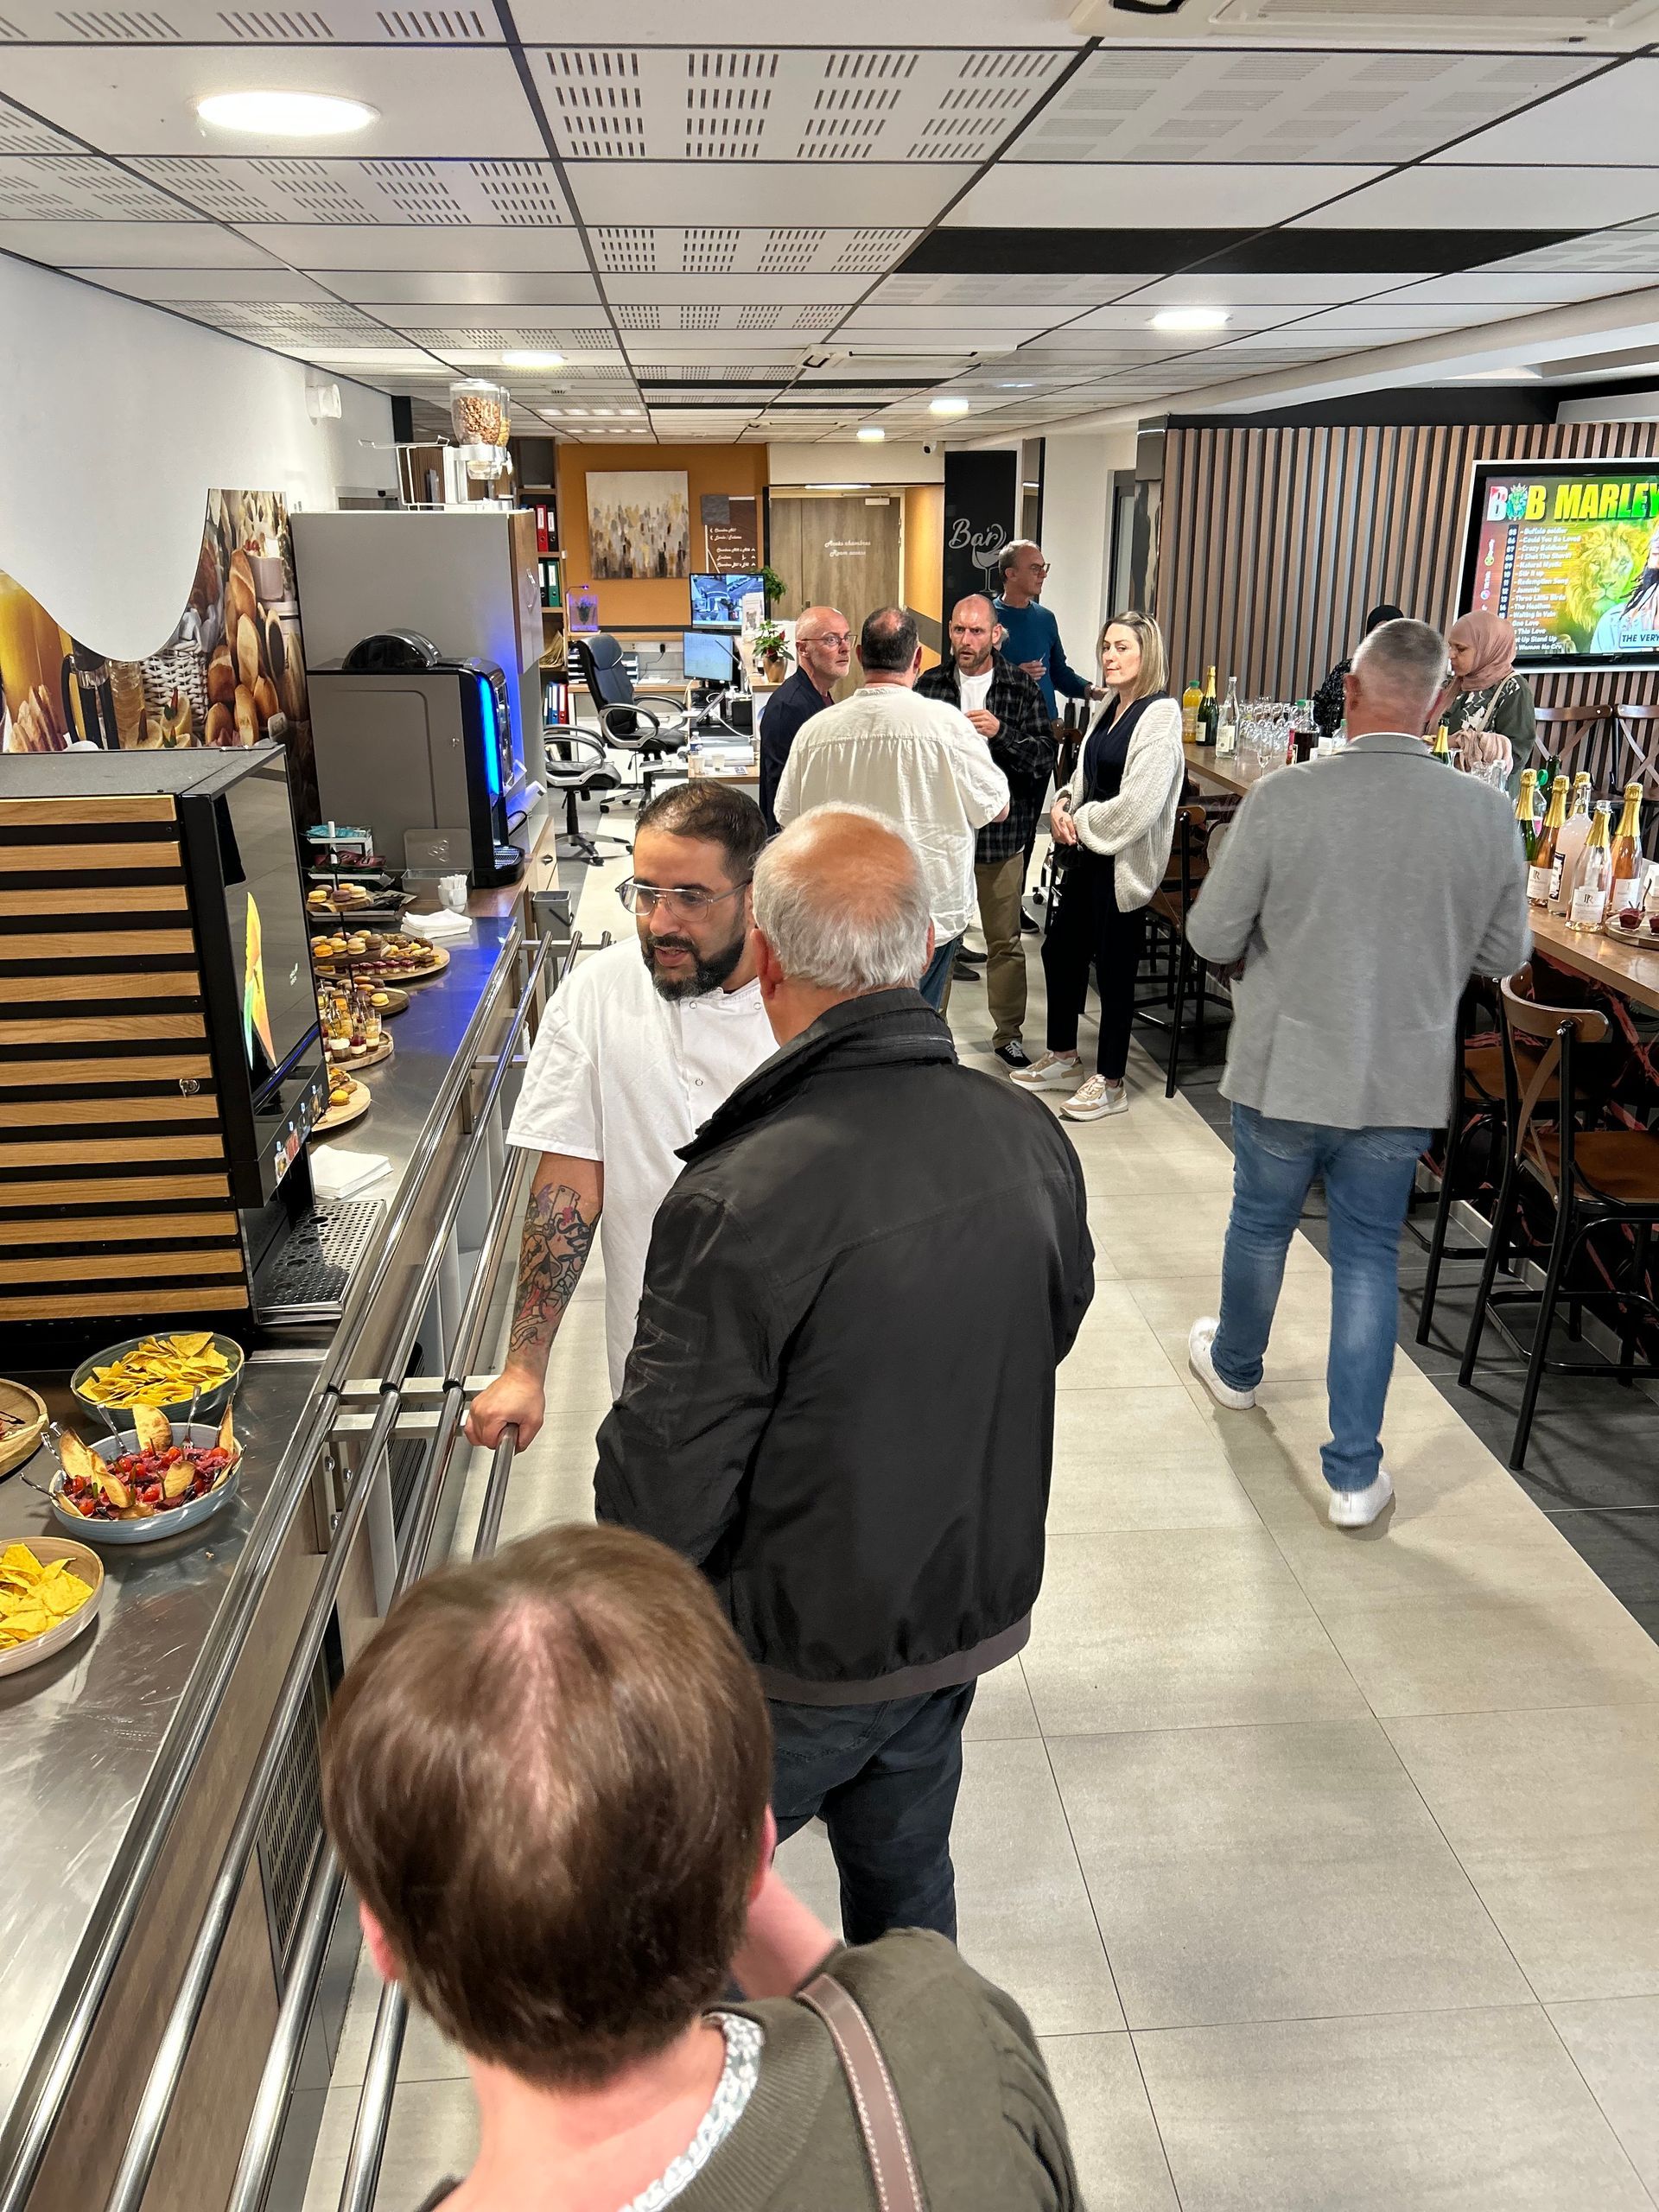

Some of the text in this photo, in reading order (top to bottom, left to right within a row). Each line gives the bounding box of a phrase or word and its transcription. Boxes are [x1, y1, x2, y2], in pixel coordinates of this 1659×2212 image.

[949, 518, 999, 549] Bar
[1622, 633, 1659, 643] THE VERY
